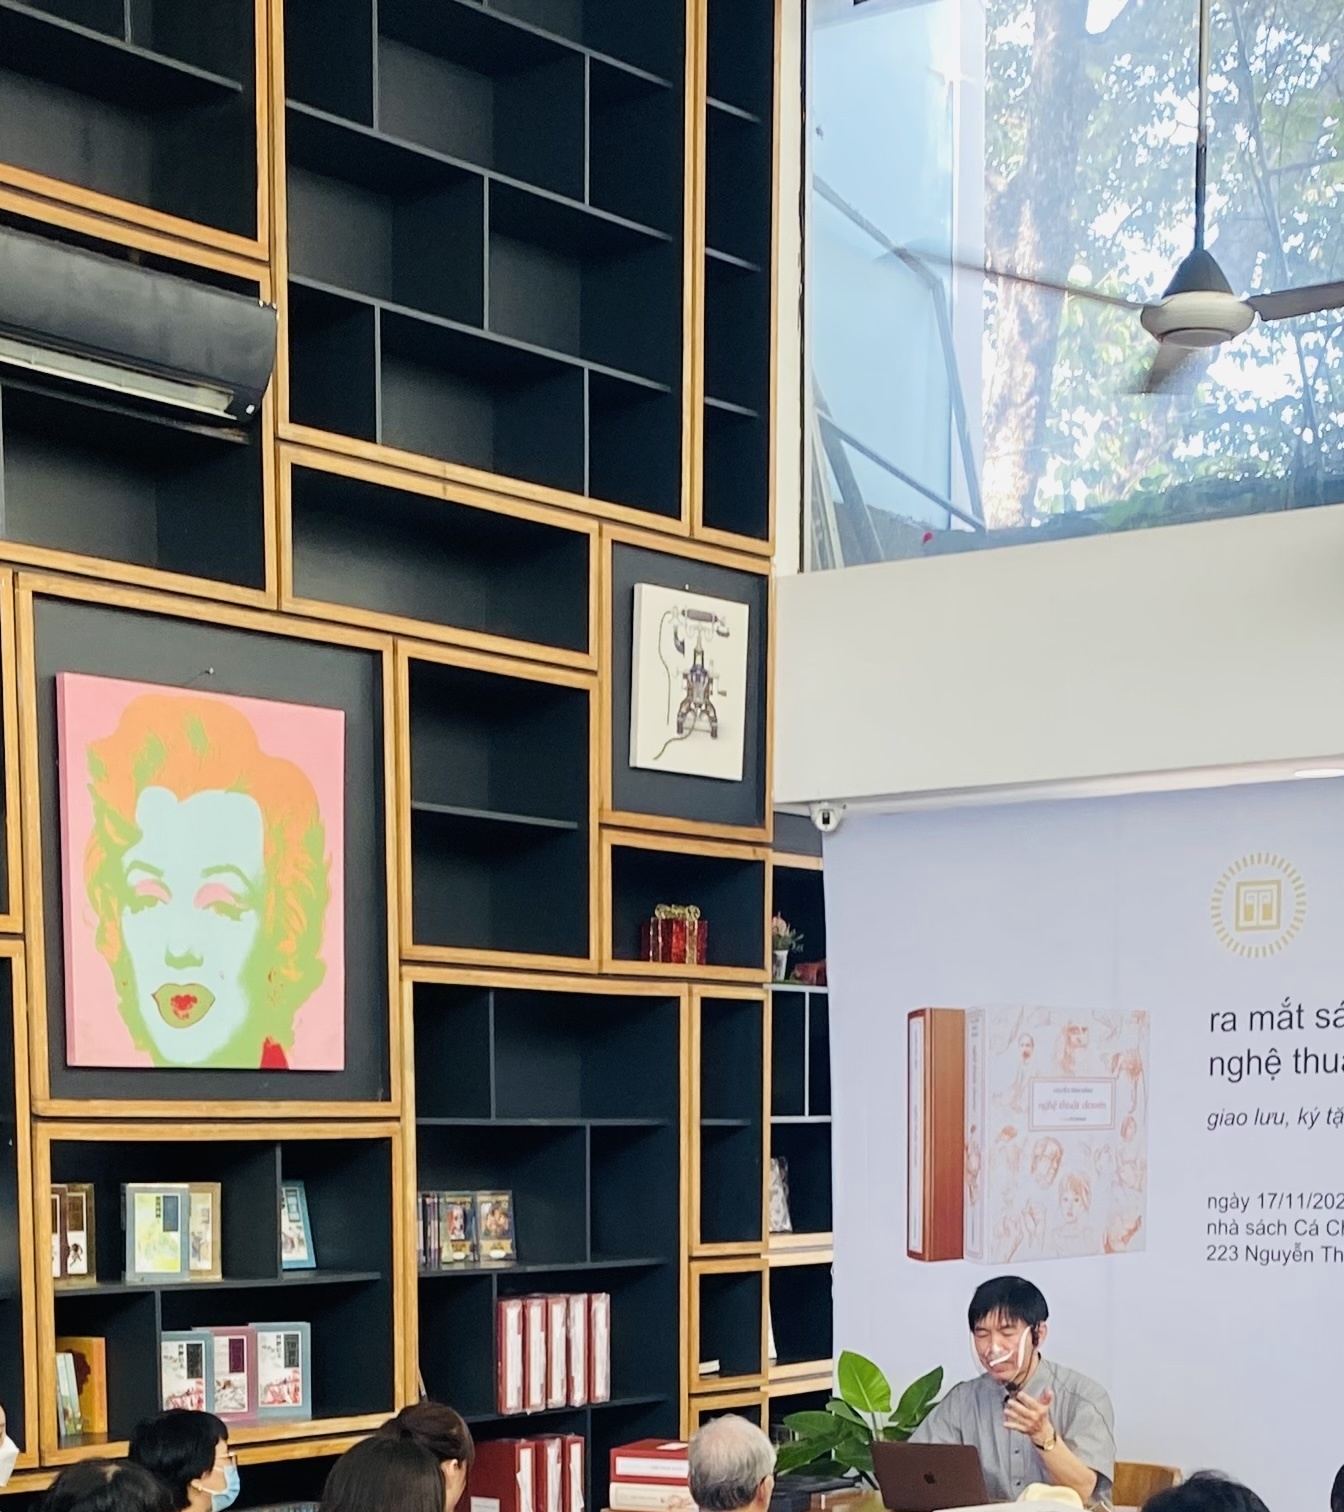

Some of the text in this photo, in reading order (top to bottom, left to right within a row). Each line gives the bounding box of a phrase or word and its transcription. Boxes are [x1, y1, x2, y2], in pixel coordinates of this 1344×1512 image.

[1210, 1010, 1237, 1033] ra
[1248, 996, 1305, 1032] mắt
[1209, 1047, 1282, 1083] nghệ
[1206, 1108, 1248, 1131] giao
[1254, 1107, 1290, 1128] lưu,
[1297, 1106, 1321, 1130] ký
[1207, 1192, 1250, 1213] ngày
[1207, 1219, 1239, 1236] nhà
[1245, 1219, 1287, 1236] sách
[1294, 1218, 1320, 1237] Cá
[1206, 1245, 1239, 1262] 223
[1245, 1242, 1314, 1266] Nguyễn
